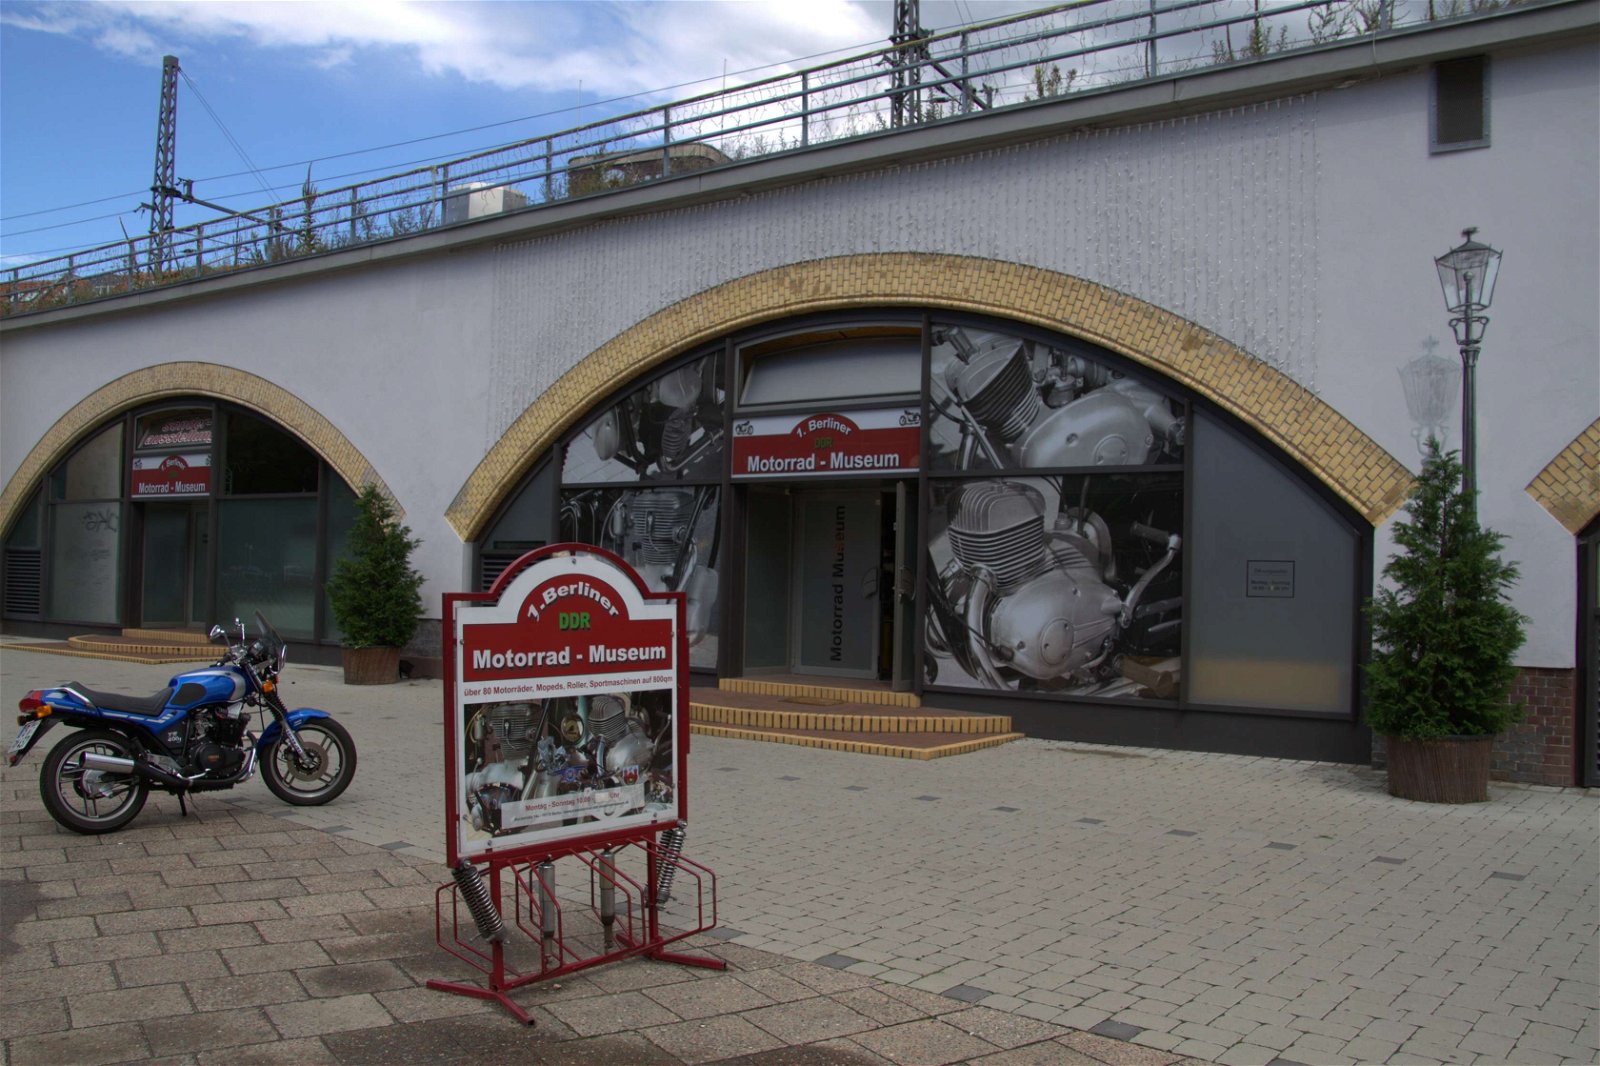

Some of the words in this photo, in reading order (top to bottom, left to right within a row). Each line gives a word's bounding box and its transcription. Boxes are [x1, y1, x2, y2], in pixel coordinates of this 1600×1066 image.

[808, 418, 852, 435] Berliner
[815, 438, 832, 449] DDR
[747, 453, 815, 472] Motorrad
[830, 452, 899, 469] Museum
[138, 482, 169, 494] Motorrad
[175, 481, 206, 493] Museum
[832, 505, 846, 578] Museum
[559, 612, 591, 630] DDR
[830, 584, 844, 662] Motorrad
[473, 646, 570, 669] Motorrad
[589, 645, 667, 663] Museum
[464, 688, 481, 696] über
[483, 687, 491, 695] 80
[589, 677, 641, 688] Sportmaschinen
[653, 675, 673, 684] 800qm
[525, 802, 547, 812] Montag
[551, 799, 575, 808] Sonntag
